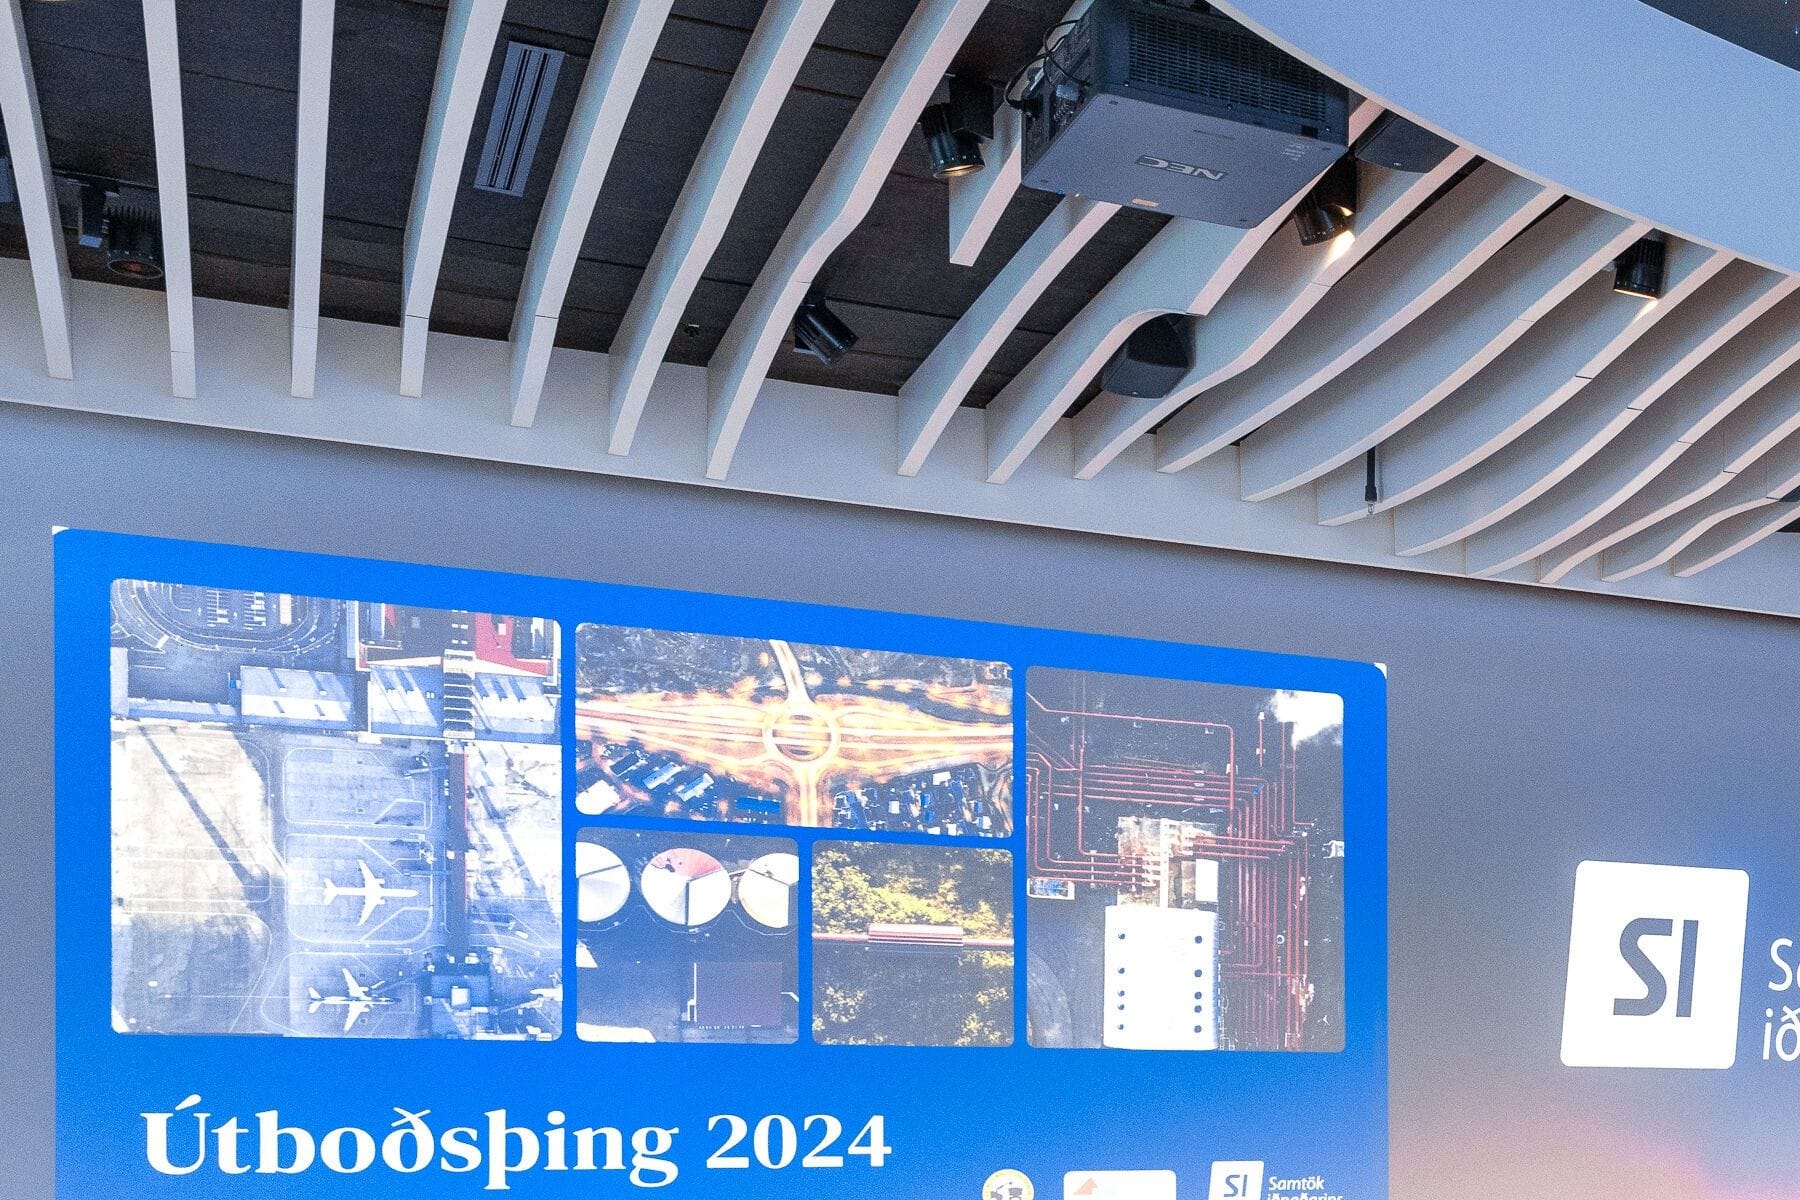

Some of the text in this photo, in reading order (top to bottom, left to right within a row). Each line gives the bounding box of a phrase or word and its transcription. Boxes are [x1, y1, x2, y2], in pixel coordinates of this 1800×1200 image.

[1138, 156, 1225, 181] NEC
[1613, 918, 1699, 1018] SI
[140, 1094, 892, 1190] Útboðsþing 2024
[1223, 1174, 1248, 1198] SI
[1268, 1175, 1325, 1191] Samtök
